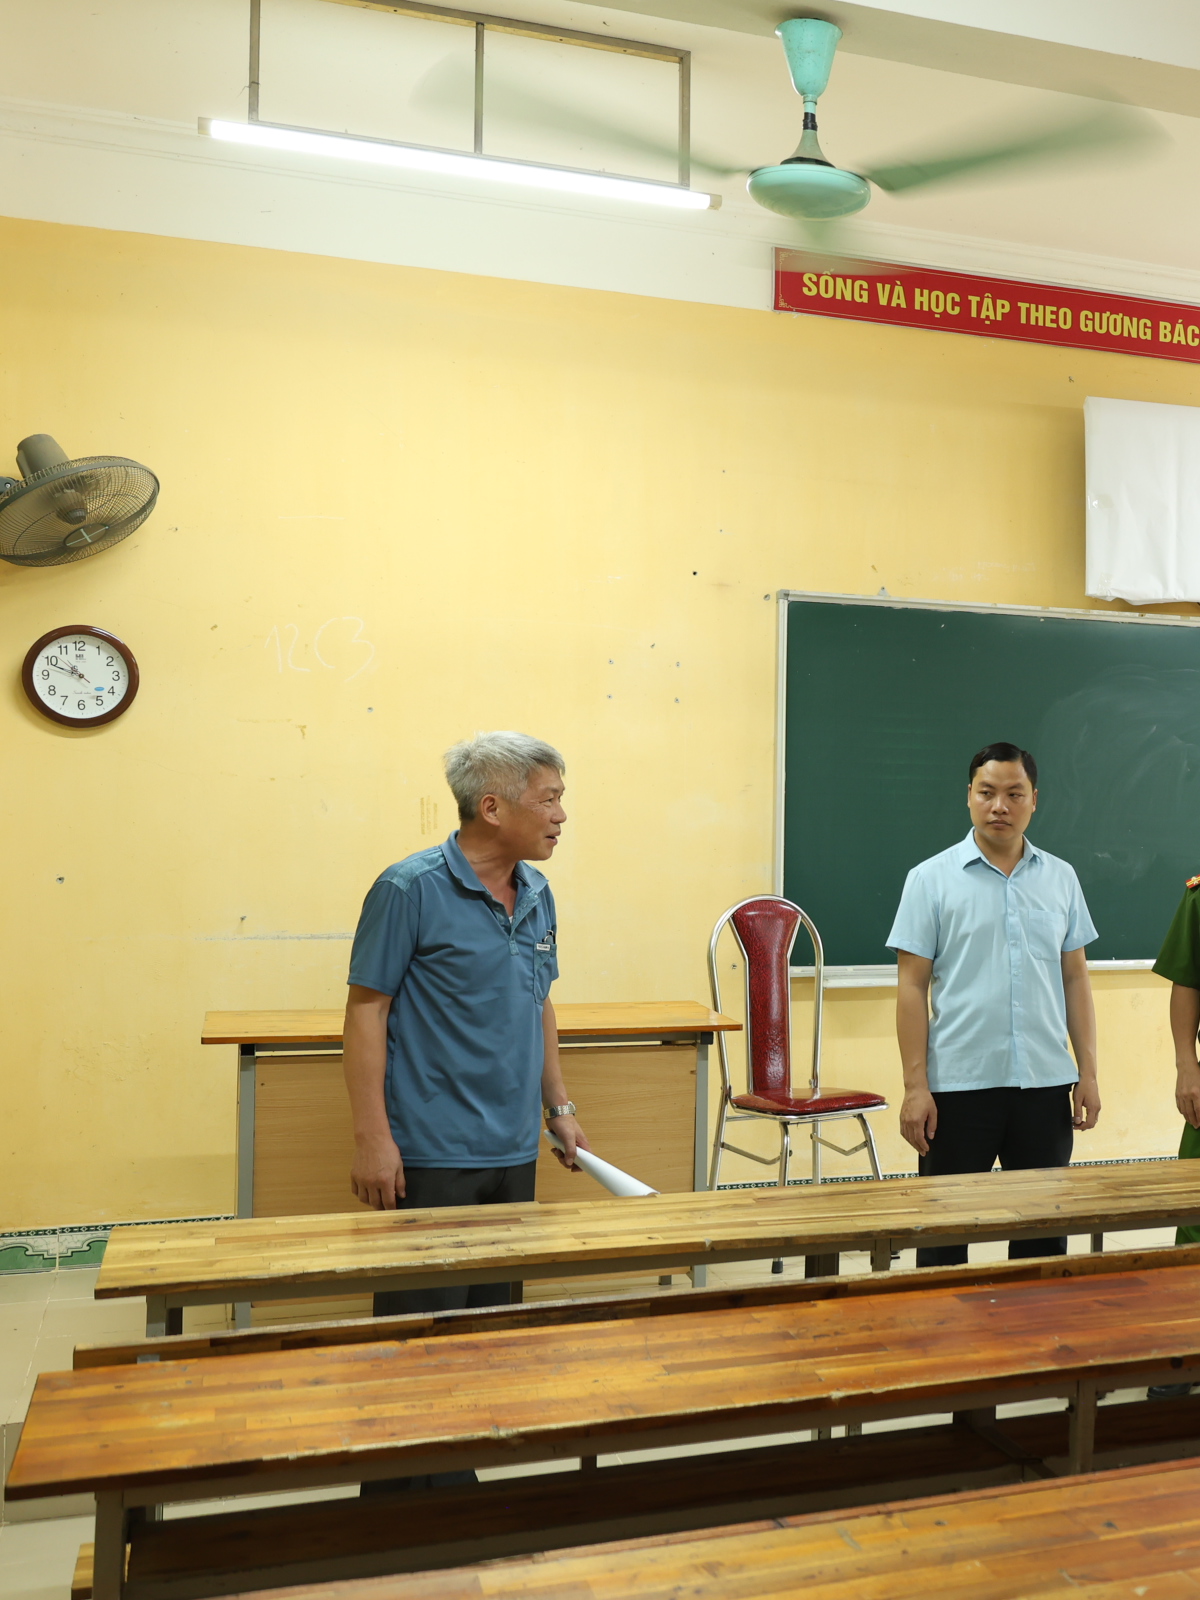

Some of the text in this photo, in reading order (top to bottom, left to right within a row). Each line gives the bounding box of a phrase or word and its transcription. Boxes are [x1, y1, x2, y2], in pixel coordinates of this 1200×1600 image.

[802, 268, 869, 304] SỐNG
[877, 280, 907, 308] VÀ
[914, 287, 961, 318] HỌC
[968, 293, 1011, 325] TẬP
[1018, 301, 1073, 330] THEO
[1079, 309, 1152, 341] GƯƠNG
[1159, 319, 1200, 347] BÁC
[58, 645, 68, 655] 11
[72, 640, 86, 652] 12
[96, 645, 100, 655] 1
[45, 655, 58, 666] 10
[106, 656, 114, 666] 2
[41, 669, 50, 680] 9
[112, 671, 120, 681] 3
[48, 685, 56, 696] 8
[107, 686, 115, 696] 4
[60, 696, 68, 705] 7
[77, 700, 86, 711] 6
[95, 696, 103, 706] 5
